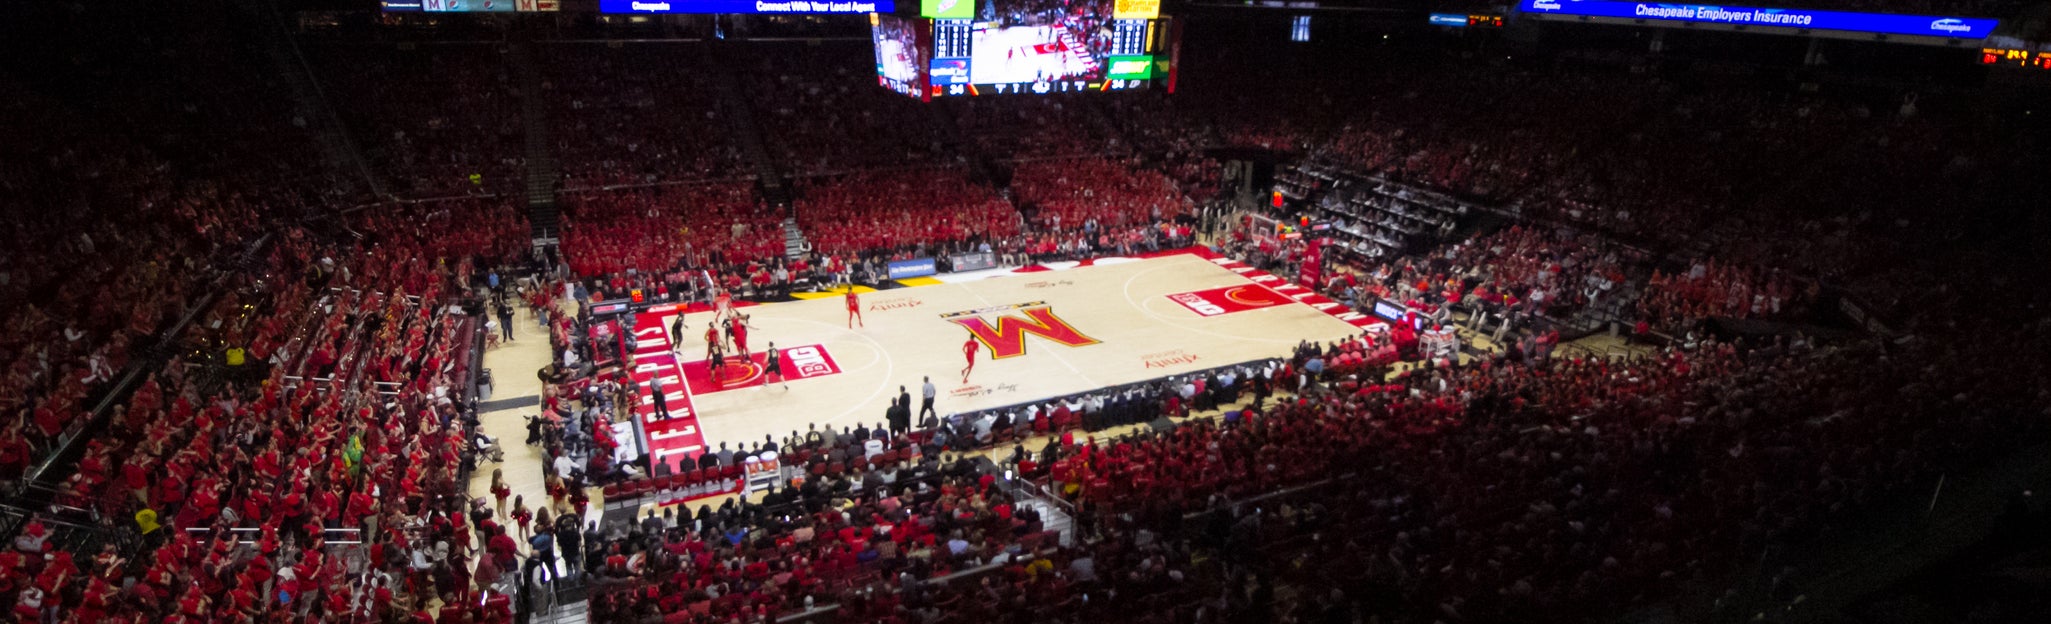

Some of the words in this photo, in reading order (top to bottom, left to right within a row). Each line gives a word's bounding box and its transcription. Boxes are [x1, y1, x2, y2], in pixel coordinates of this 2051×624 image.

[756, 1, 790, 11] Connect
[790, 1, 810, 11] With
[810, 1, 829, 12] Your
[830, 1, 851, 12] Local
[852, 1, 875, 12] Agent
[1533, 0, 1561, 11] Chesapeake
[1635, 3, 1695, 18] Chesapeake
[1696, 7, 1752, 22] Employers
[1753, 10, 1812, 25] Insurance
[1931, 20, 1971, 33] Chesapeake
[945, 304, 1102, 361] M
